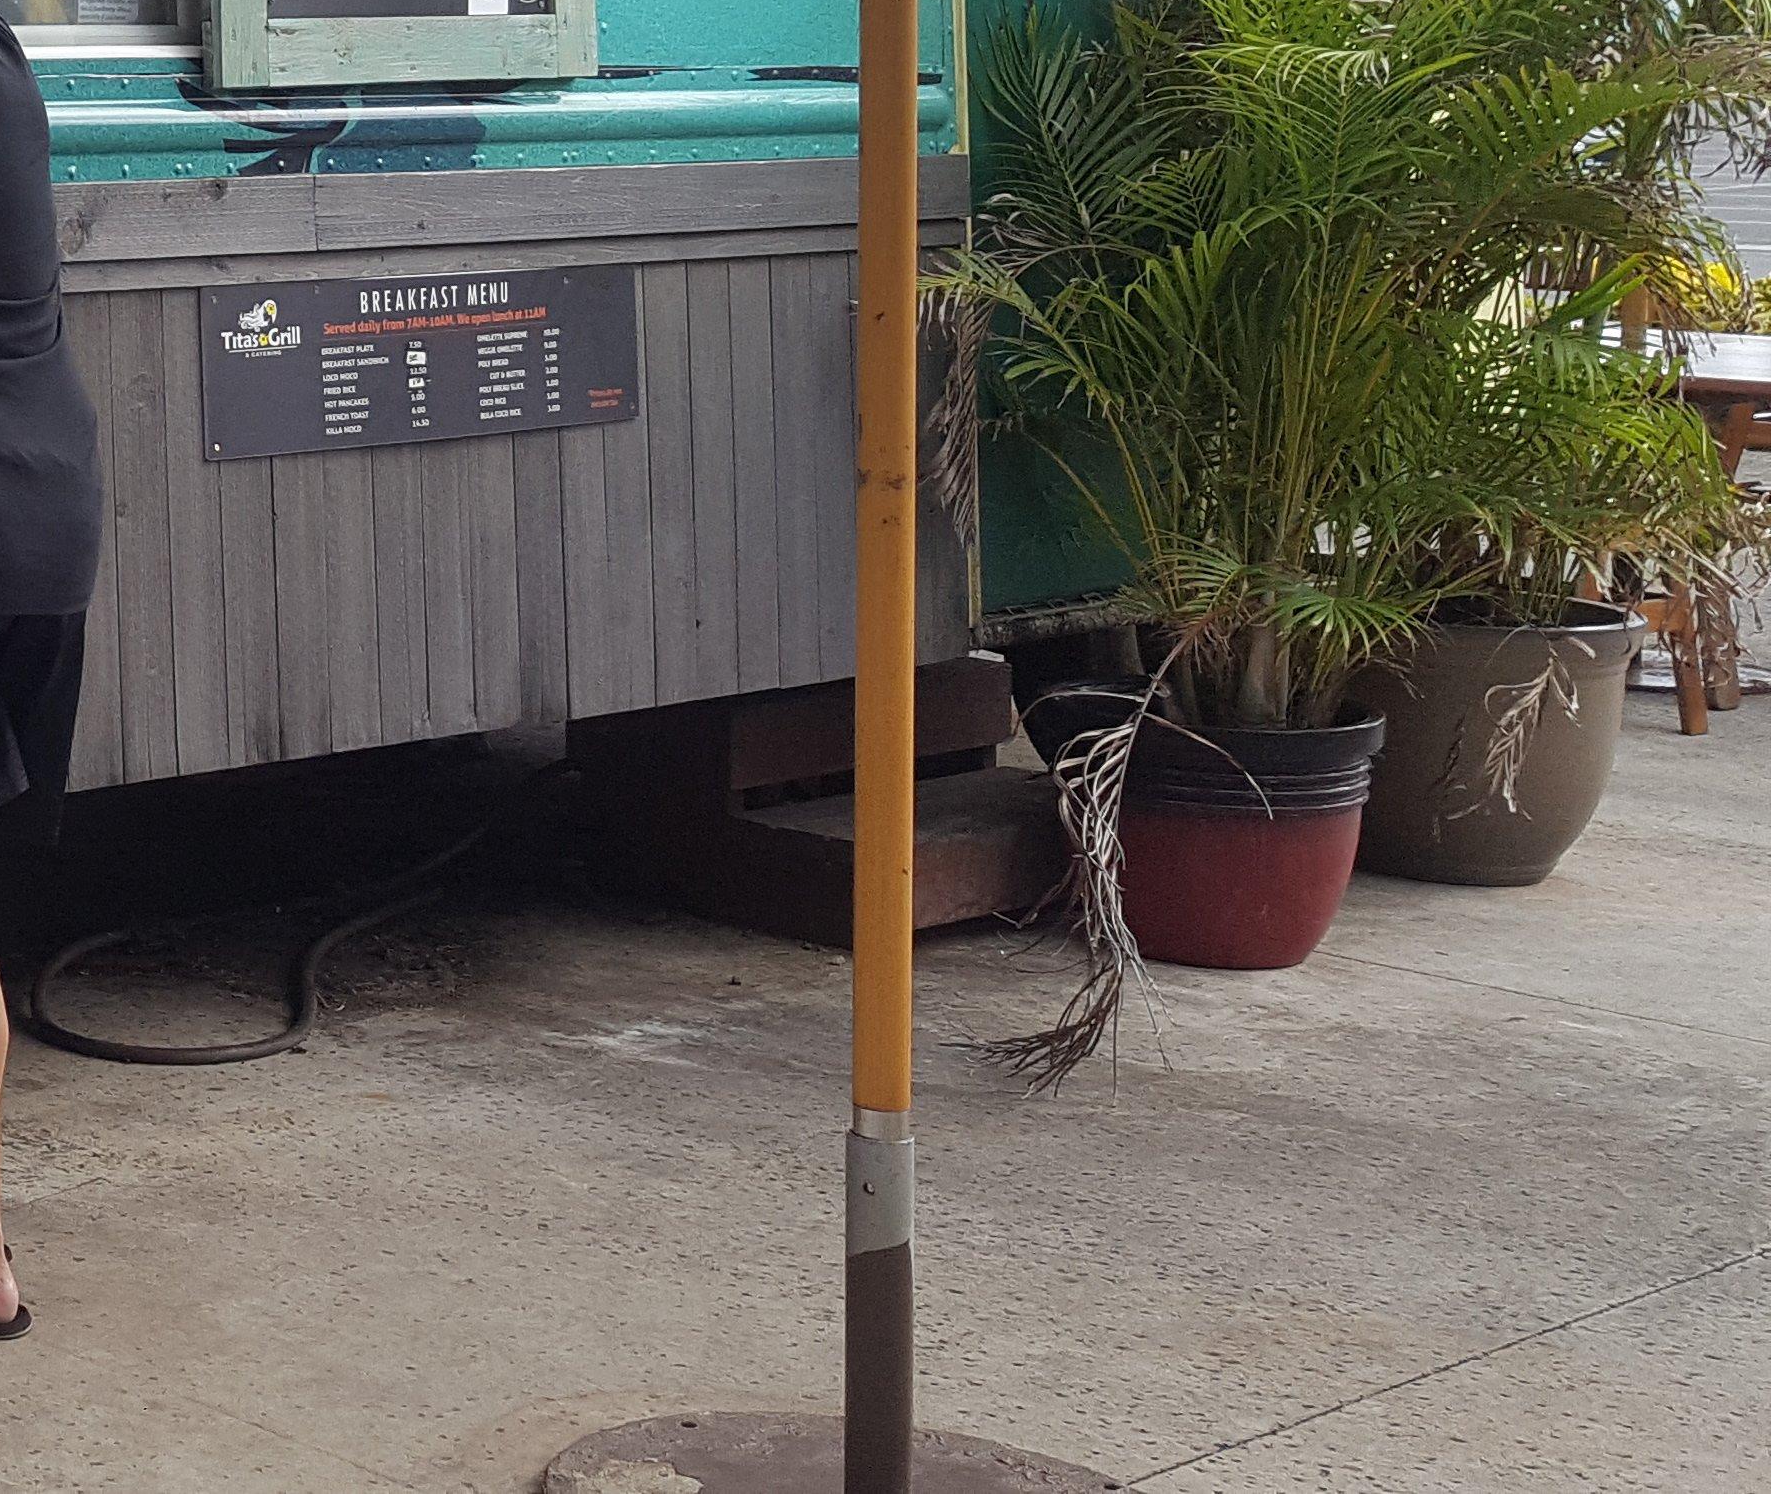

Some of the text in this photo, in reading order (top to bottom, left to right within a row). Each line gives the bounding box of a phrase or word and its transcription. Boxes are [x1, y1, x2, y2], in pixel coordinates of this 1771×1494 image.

[359, 282, 509, 314] BREAKFAST MENU
[323, 322, 355, 335] Served
[357, 320, 381, 334] daily
[383, 319, 405, 330] from
[457, 312, 469, 324] We
[471, 313, 490, 326] open
[491, 308, 513, 323] lunch
[525, 306, 547, 318] 11AM
[221, 326, 301, 350] Tita's Grill
[251, 350, 281, 358] CATERING
[321, 344, 374, 355] BREAKFAST PLATE
[322, 359, 355, 368] BREAKFAST
[323, 374, 338, 382] LOCO
[323, 386, 356, 395] FRIED RICE
[338, 398, 369, 408] PANCAKES
[325, 411, 369, 422] FRENCH TOAST
